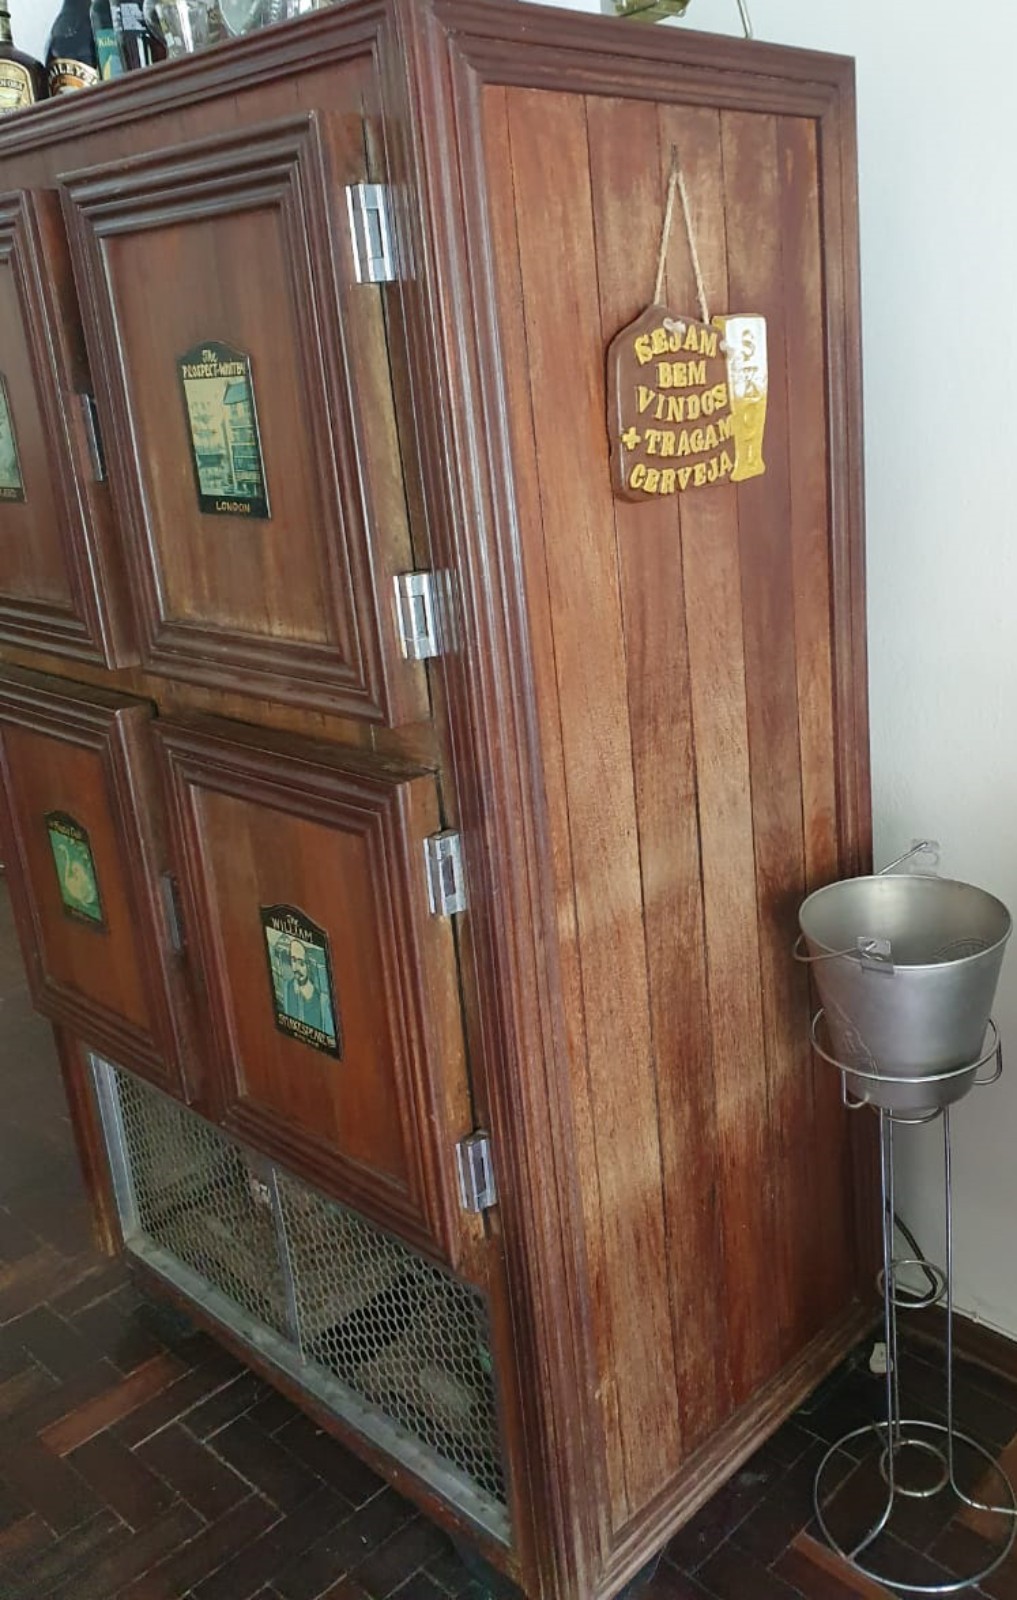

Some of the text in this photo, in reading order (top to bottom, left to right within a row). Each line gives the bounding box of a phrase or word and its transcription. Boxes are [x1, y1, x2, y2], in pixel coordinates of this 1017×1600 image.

[634, 325, 718, 365] SEJAM
[656, 360, 707, 389] BEM
[637, 383, 728, 423] VINDOS
[645, 415, 735, 457] TRAGAM
[629, 451, 734, 494] CERVEJA
[215, 500, 251, 513] LONDON
